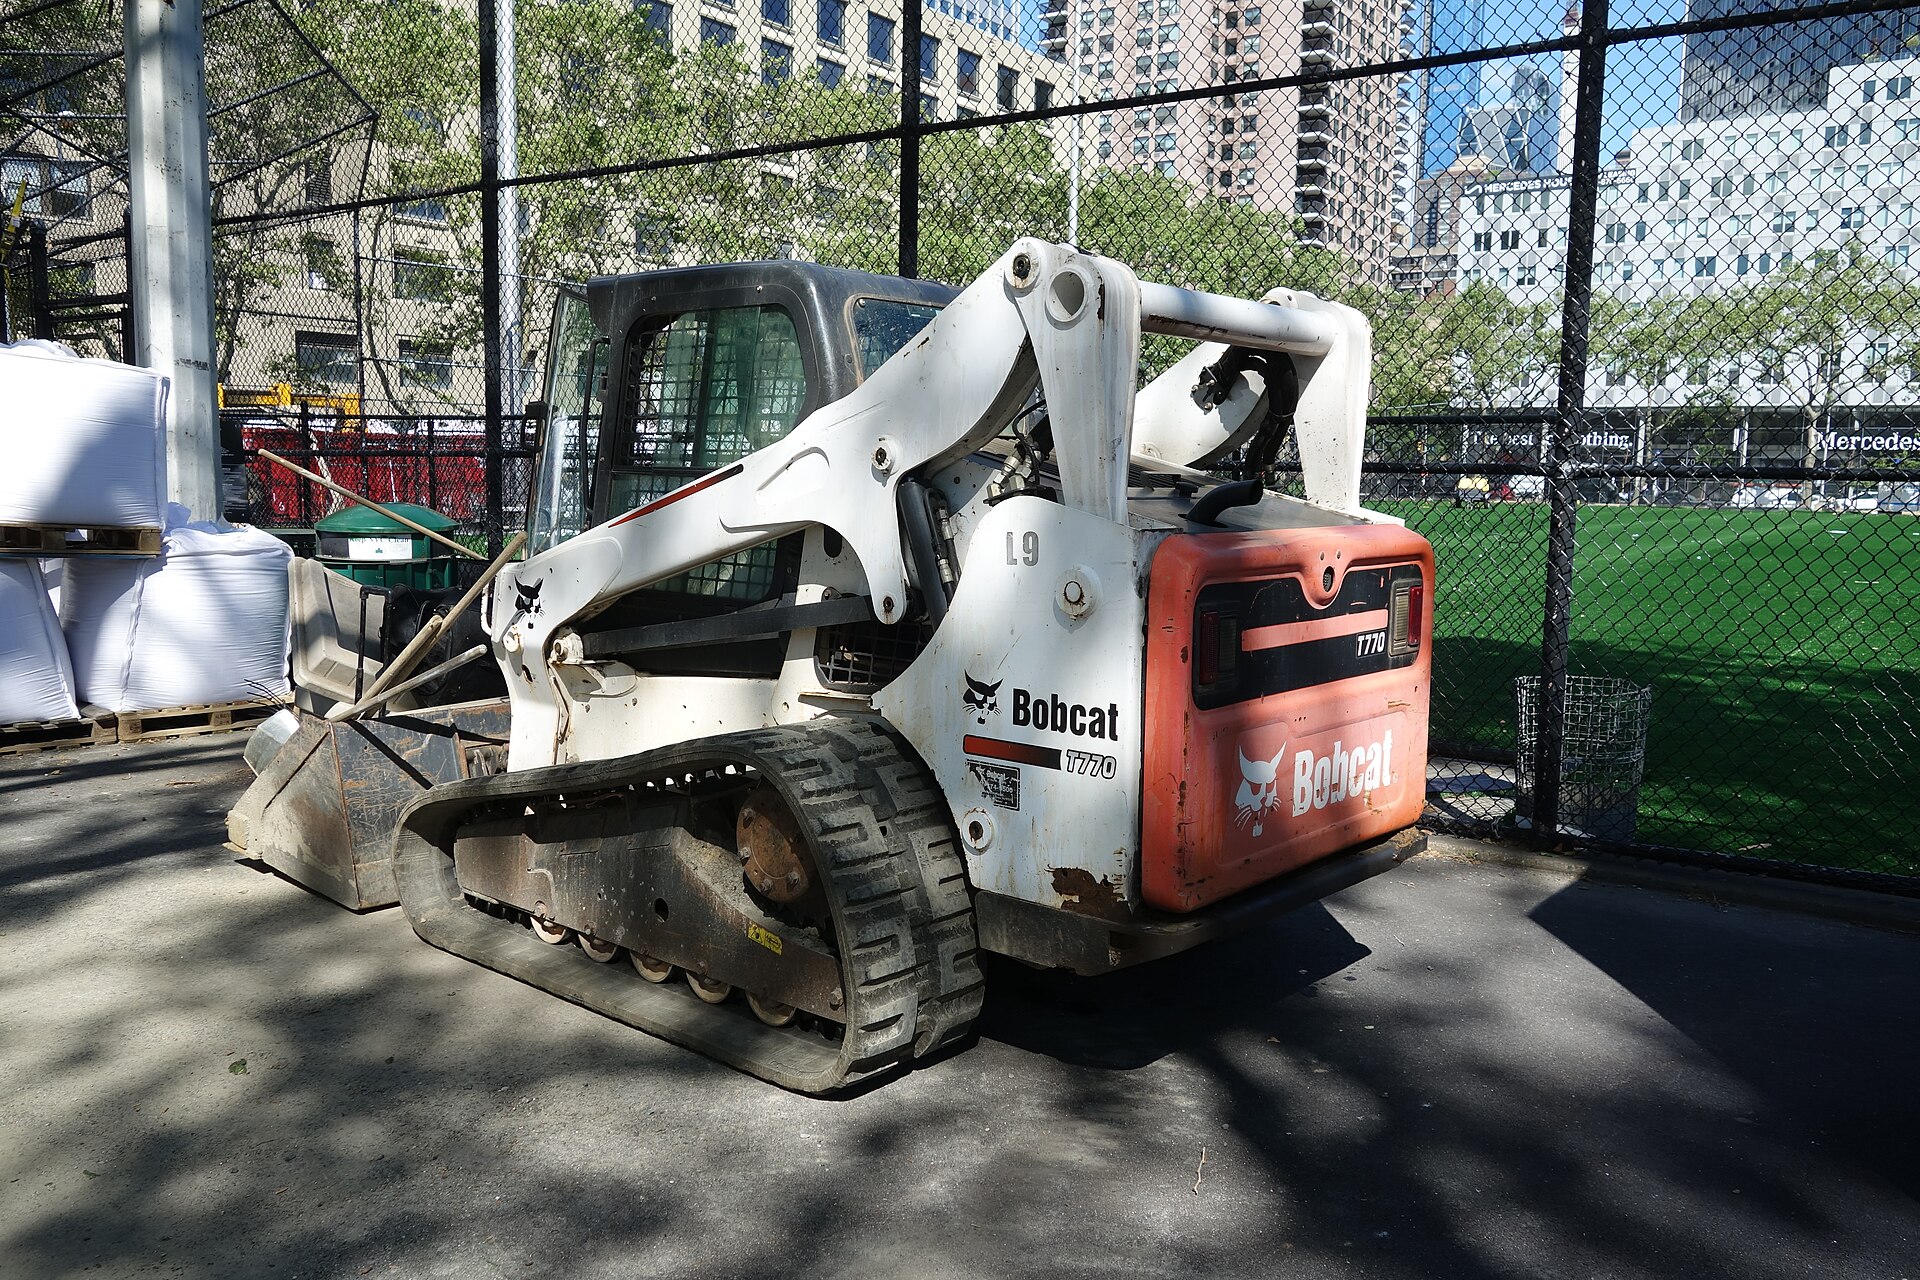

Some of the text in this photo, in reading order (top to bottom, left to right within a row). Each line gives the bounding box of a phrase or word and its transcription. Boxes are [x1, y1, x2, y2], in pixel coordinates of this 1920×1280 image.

[1484, 176, 1573, 193] MERCEDES HOUS
[1580, 431, 1633, 450] othing.
[1357, 632, 1386, 657] T770
[1012, 688, 1119, 741] Bobcat
[1066, 749, 1117, 780] T770
[1292, 729, 1393, 818] Bobcat
